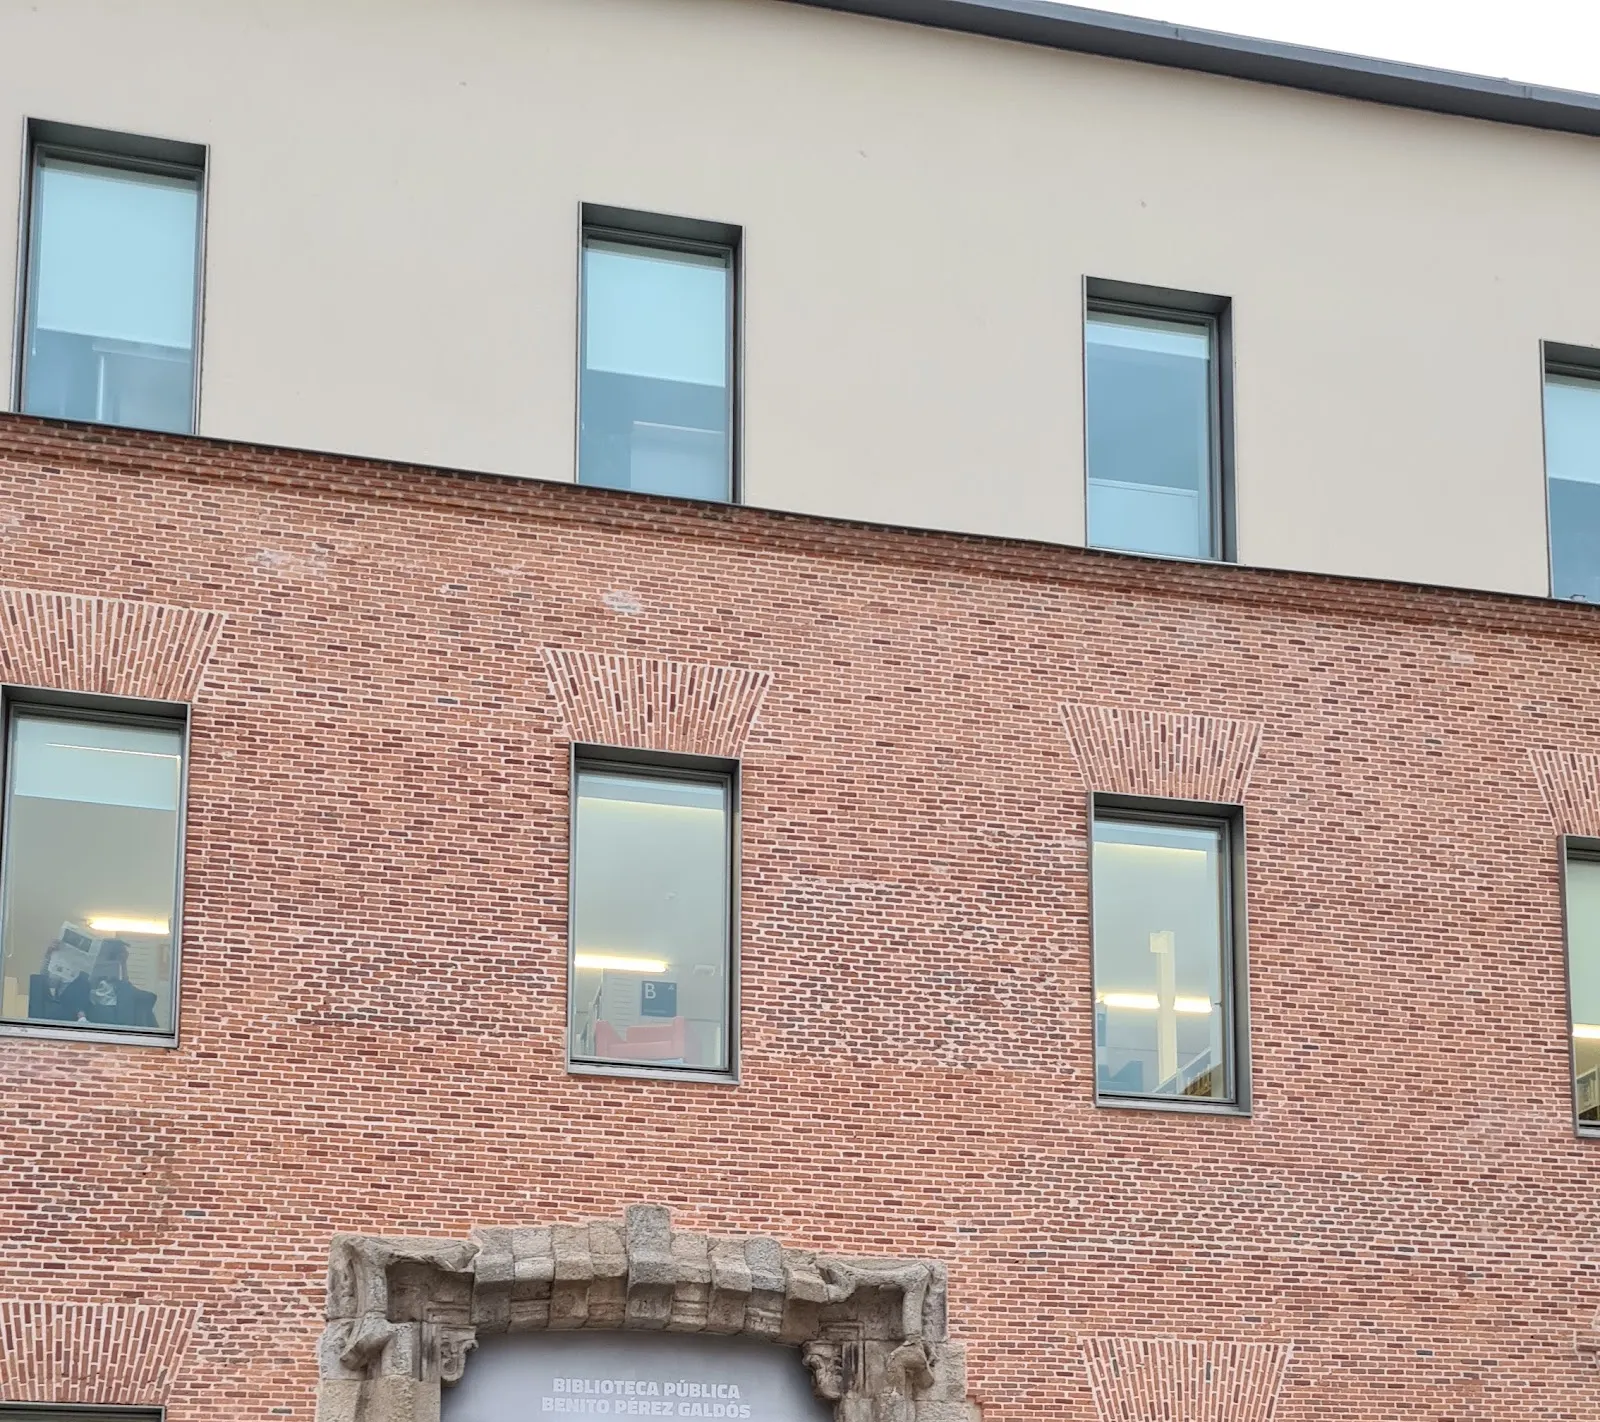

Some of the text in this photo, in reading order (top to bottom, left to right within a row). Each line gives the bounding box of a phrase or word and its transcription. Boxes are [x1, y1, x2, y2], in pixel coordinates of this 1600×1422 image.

[644, 982, 657, 999] B
[552, 1378, 741, 1399] BIBLIOTECA PÚBLICA
[541, 1396, 752, 1419] BENITO PÉREZ GALDÓS
